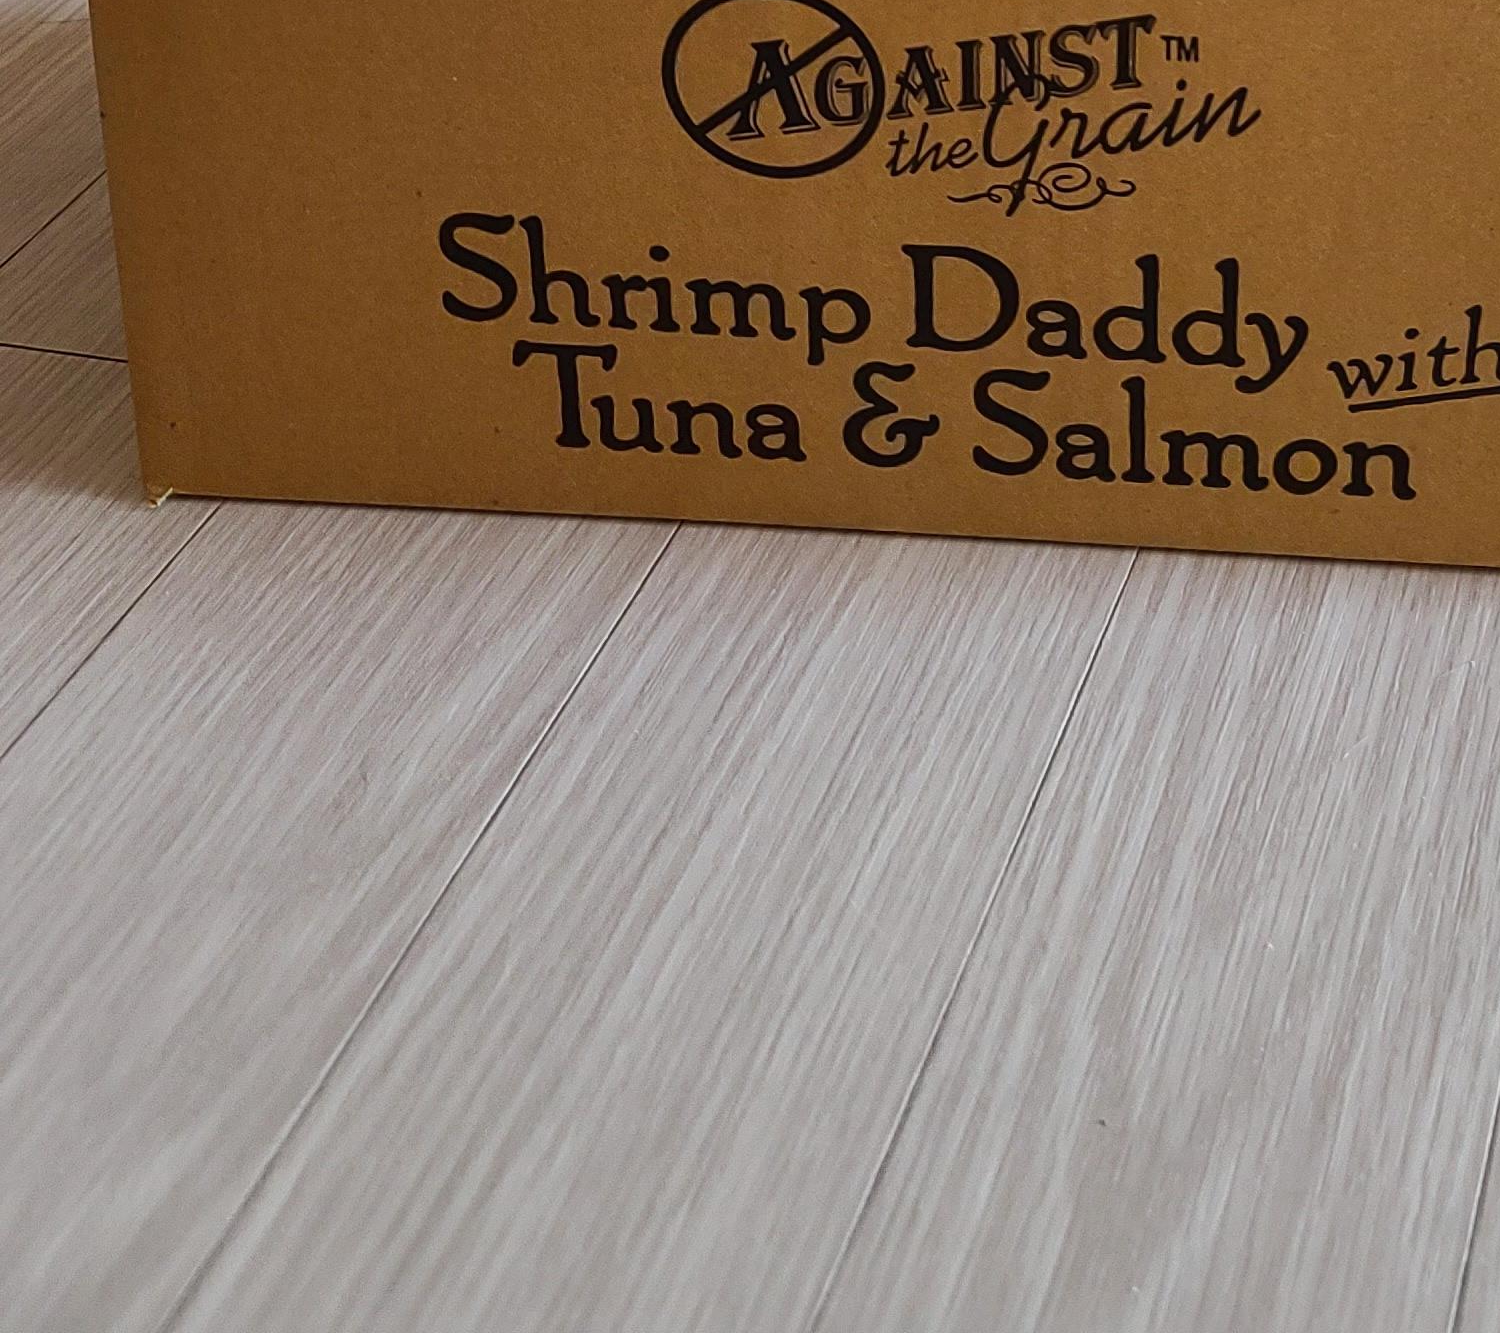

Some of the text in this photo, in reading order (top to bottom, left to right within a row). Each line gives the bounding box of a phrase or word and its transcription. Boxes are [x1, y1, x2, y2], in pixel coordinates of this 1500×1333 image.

[726, 14, 1157, 142] AGAINST
[886, 75, 1262, 217] the Grain
[439, 213, 872, 367] Shrimp
[901, 244, 1309, 394] Daddy
[512, 340, 1417, 501] Tuna & Salmon
